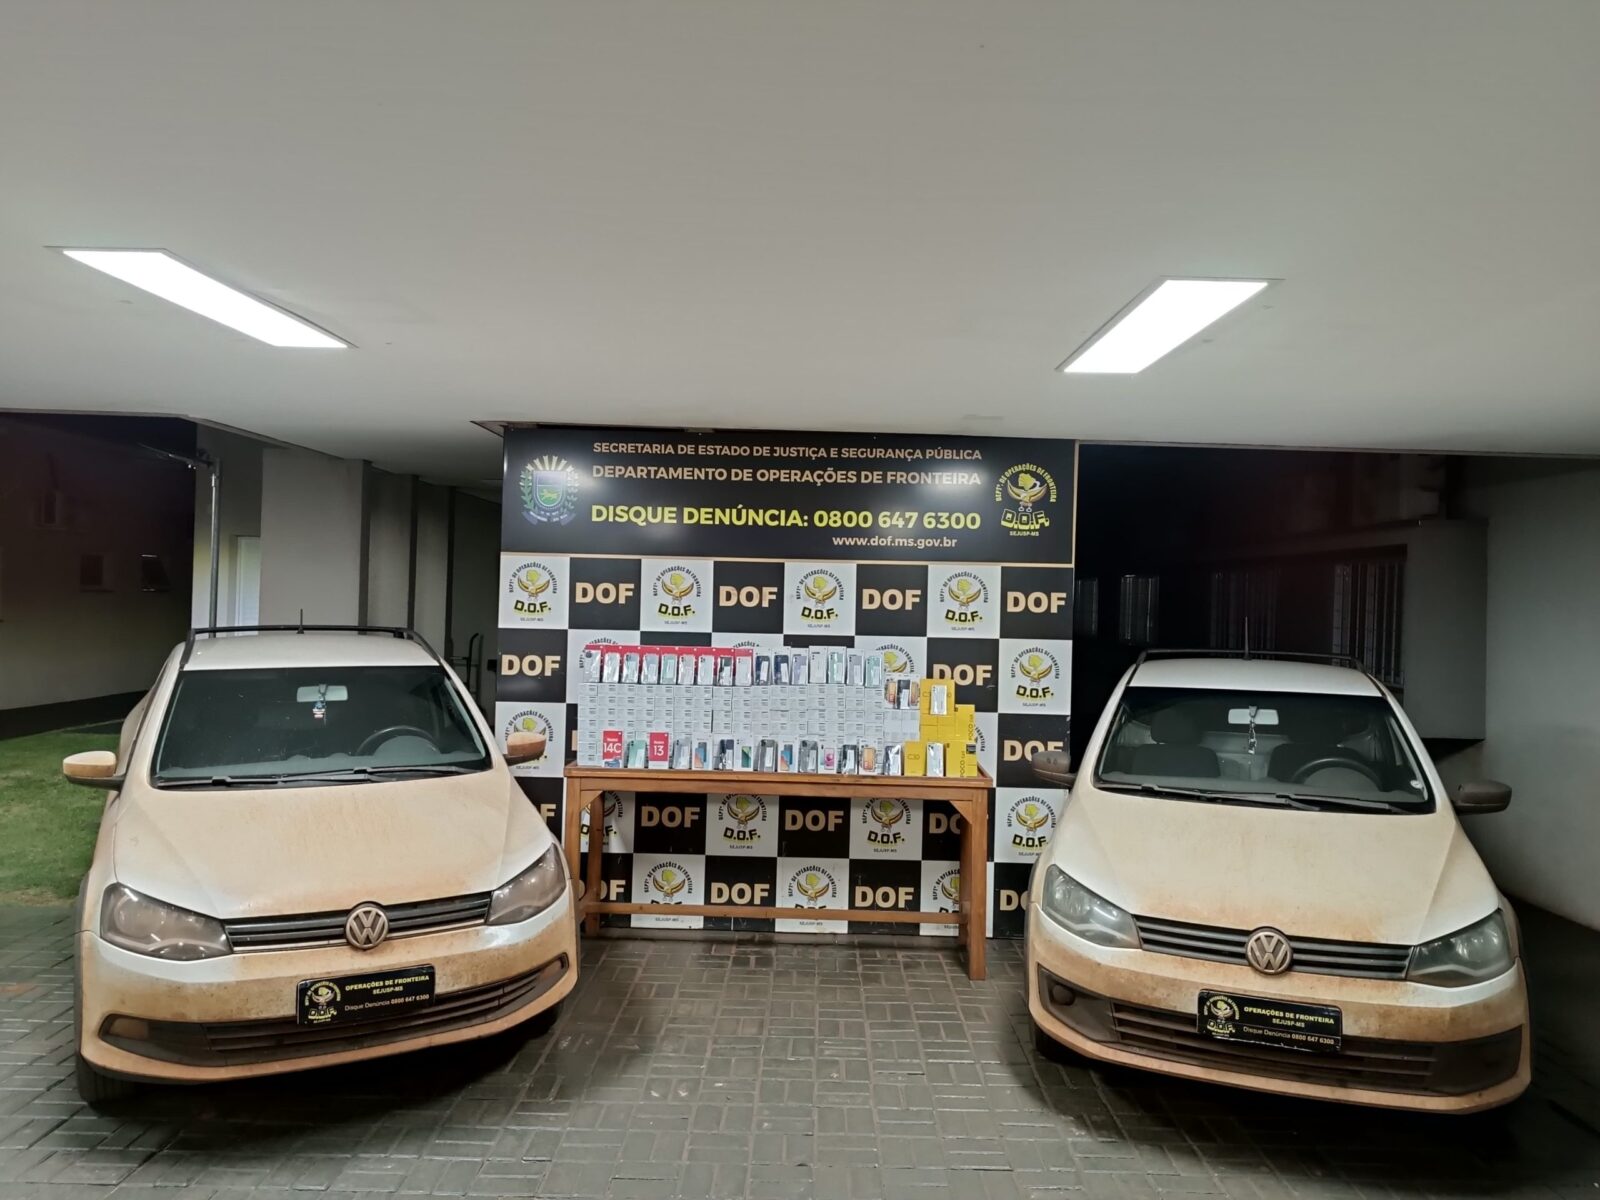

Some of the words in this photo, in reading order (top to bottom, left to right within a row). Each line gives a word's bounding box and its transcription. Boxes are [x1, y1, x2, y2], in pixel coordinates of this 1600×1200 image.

[593, 443, 675, 455] SECRETARIA
[678, 444, 695, 455] DE
[698, 445, 750, 456] ESTADO
[753, 446, 771, 456] DE
[773, 446, 828, 460] JUSTIÇA
[830, 448, 838, 458] E
[841, 448, 923, 461] SEGURANÇA
[926, 447, 982, 460] PÚBLICA
[592, 465, 728, 480] DEPARTAMENTO
[731, 469, 753, 481] DE
[757, 468, 857, 486] OPERAÇÕES
[861, 471, 883, 484] DE
[887, 472, 982, 485] FRONTEIRA
[592, 505, 677, 526] DISQUE
[683, 504, 808, 527] DENÚNCIA:
[813, 510, 873, 528] 0800
[878, 511, 918, 529] 647
[923, 512, 981, 529] 6300
[1001, 509, 1049, 529] D.O.F.
[832, 536, 957, 549] www.dof.ms.gov.br
[575, 582, 634, 604] DOF
[719, 586, 777, 607] DOF
[862, 589, 921, 610] DOF
[514, 600, 551, 613] D.O.F.
[658, 603, 695, 616] D.O.F.
[1007, 592, 1067, 613] DOF
[801, 607, 838, 619] D.O.F.
[945, 609, 982, 622] D.O.F.
[501, 654, 561, 676] DOF
[933, 664, 992, 686] DOF
[1016, 685, 1054, 698] D.O.F.
[603, 742, 621, 753] 14C
[653, 746, 664, 756] 13
[1004, 740, 1063, 761] DOF
[641, 806, 700, 828] DOF
[785, 810, 844, 831] DOF
[724, 827, 761, 840] D.O.F.
[867, 830, 905, 844] D.O.F.
[652, 861, 677, 872] OPERAÇÕES
[796, 865, 821, 877] OPERAÇÕES
[711, 882, 770, 904] DOF
[855, 886, 914, 908] DOF
[345, 981, 384, 991] OPERAÇÕES
[395, 975, 429, 984] FRONTEIRA
[373, 986, 403, 995] SEJUSP-MS
[1244, 1006, 1283, 1017] OPERAÇÕES
[1296, 1014, 1334, 1024] FRONTEIRA
[1272, 1018, 1305, 1027] SEJUSP-MS
[1264, 1030, 1290, 1039] Denúncia
